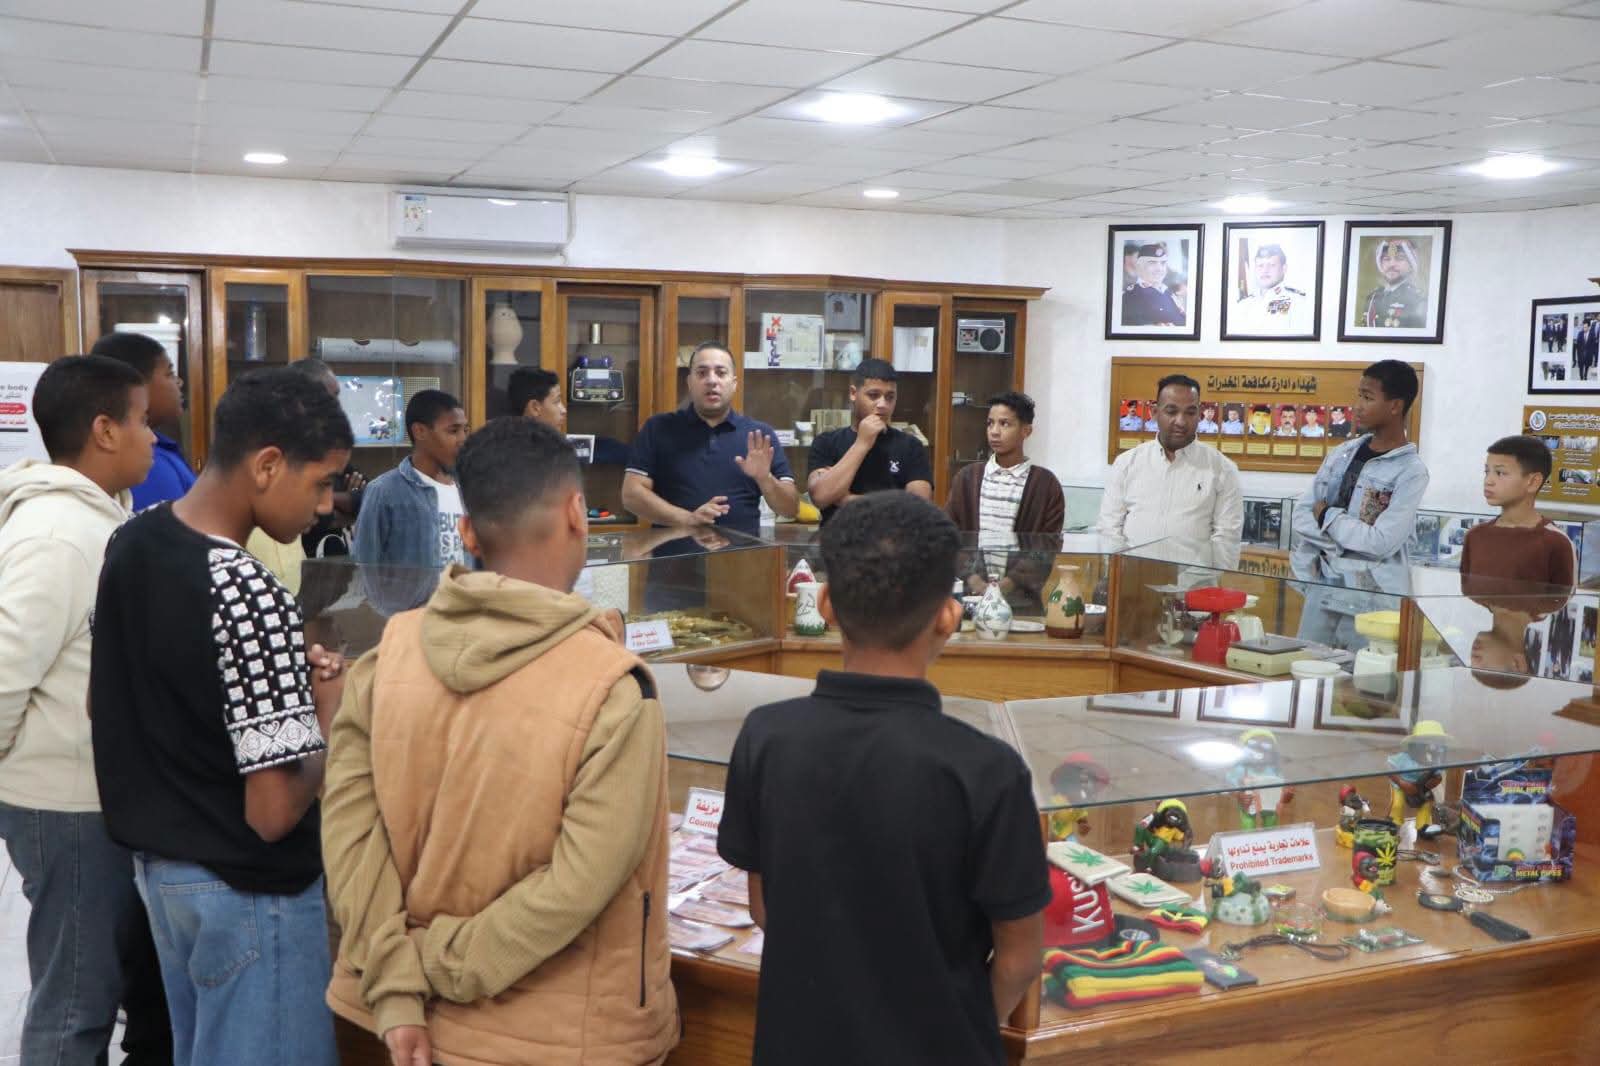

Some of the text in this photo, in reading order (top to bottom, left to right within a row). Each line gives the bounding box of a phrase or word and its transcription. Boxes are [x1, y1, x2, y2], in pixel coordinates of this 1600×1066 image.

[766, 316, 781, 366] FedEx
[1241, 375, 1271, 388] مكافحة
[689, 816, 719, 829] Counte
[1227, 837, 1311, 857] علامات تجارية يمنع تداولها
[1230, 853, 1314, 871] Prohibited Trademarks
